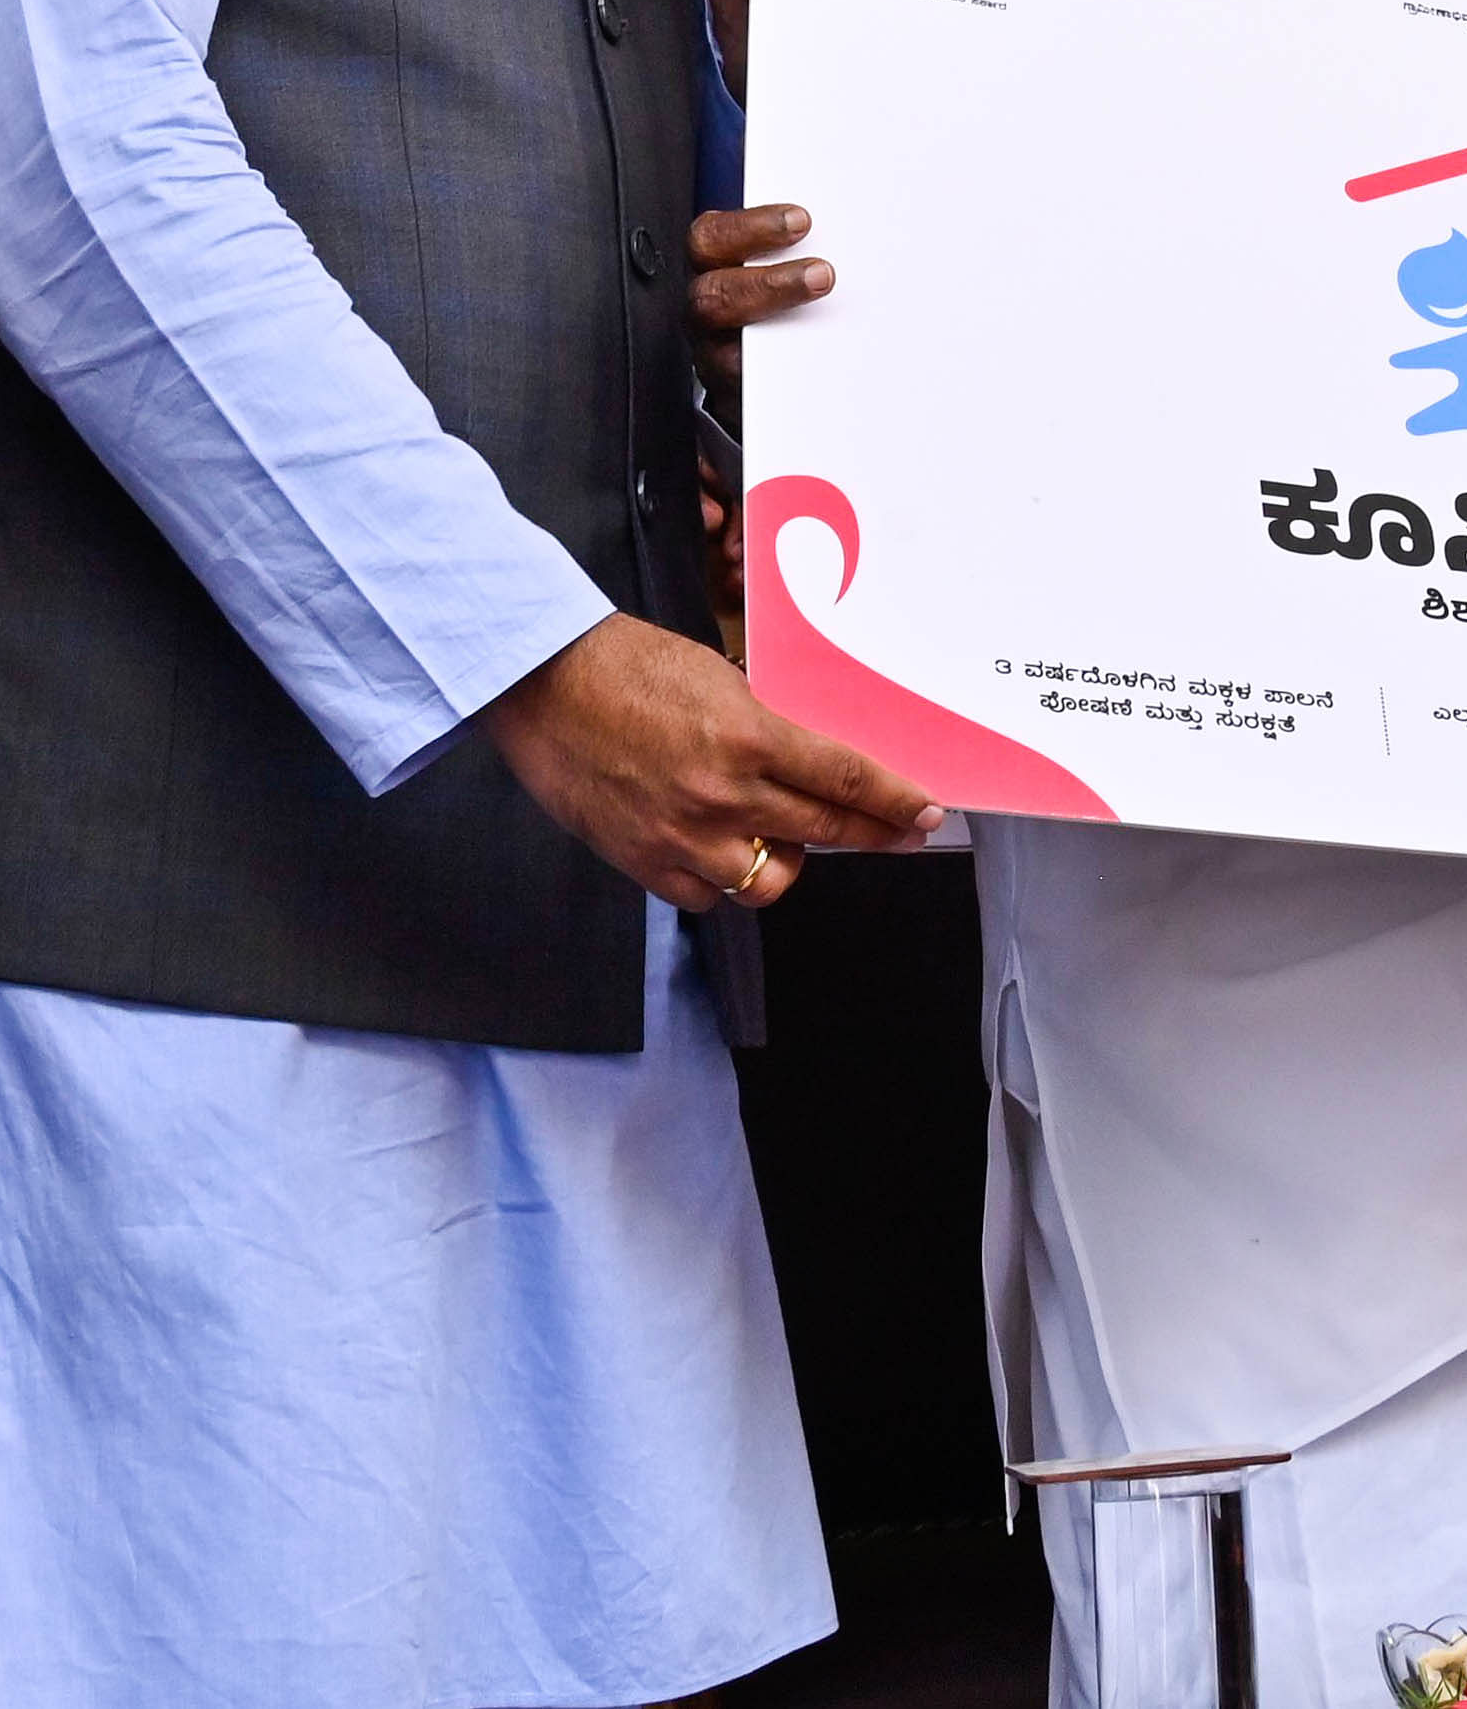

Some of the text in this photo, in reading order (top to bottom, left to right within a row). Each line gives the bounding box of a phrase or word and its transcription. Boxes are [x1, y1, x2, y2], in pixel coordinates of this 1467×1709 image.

[1024, 660, 1176, 693] ವರ್ಷದೊಳಗಿನ
[1188, 677, 1252, 708] ಮಕ್ಕಳ
[1263, 689, 1334, 709] ಪಾಲನೆ
[1145, 701, 1203, 731] ಮತ್ತು
[1215, 708, 1296, 741] ಸುರಕ್ಷತೆ
